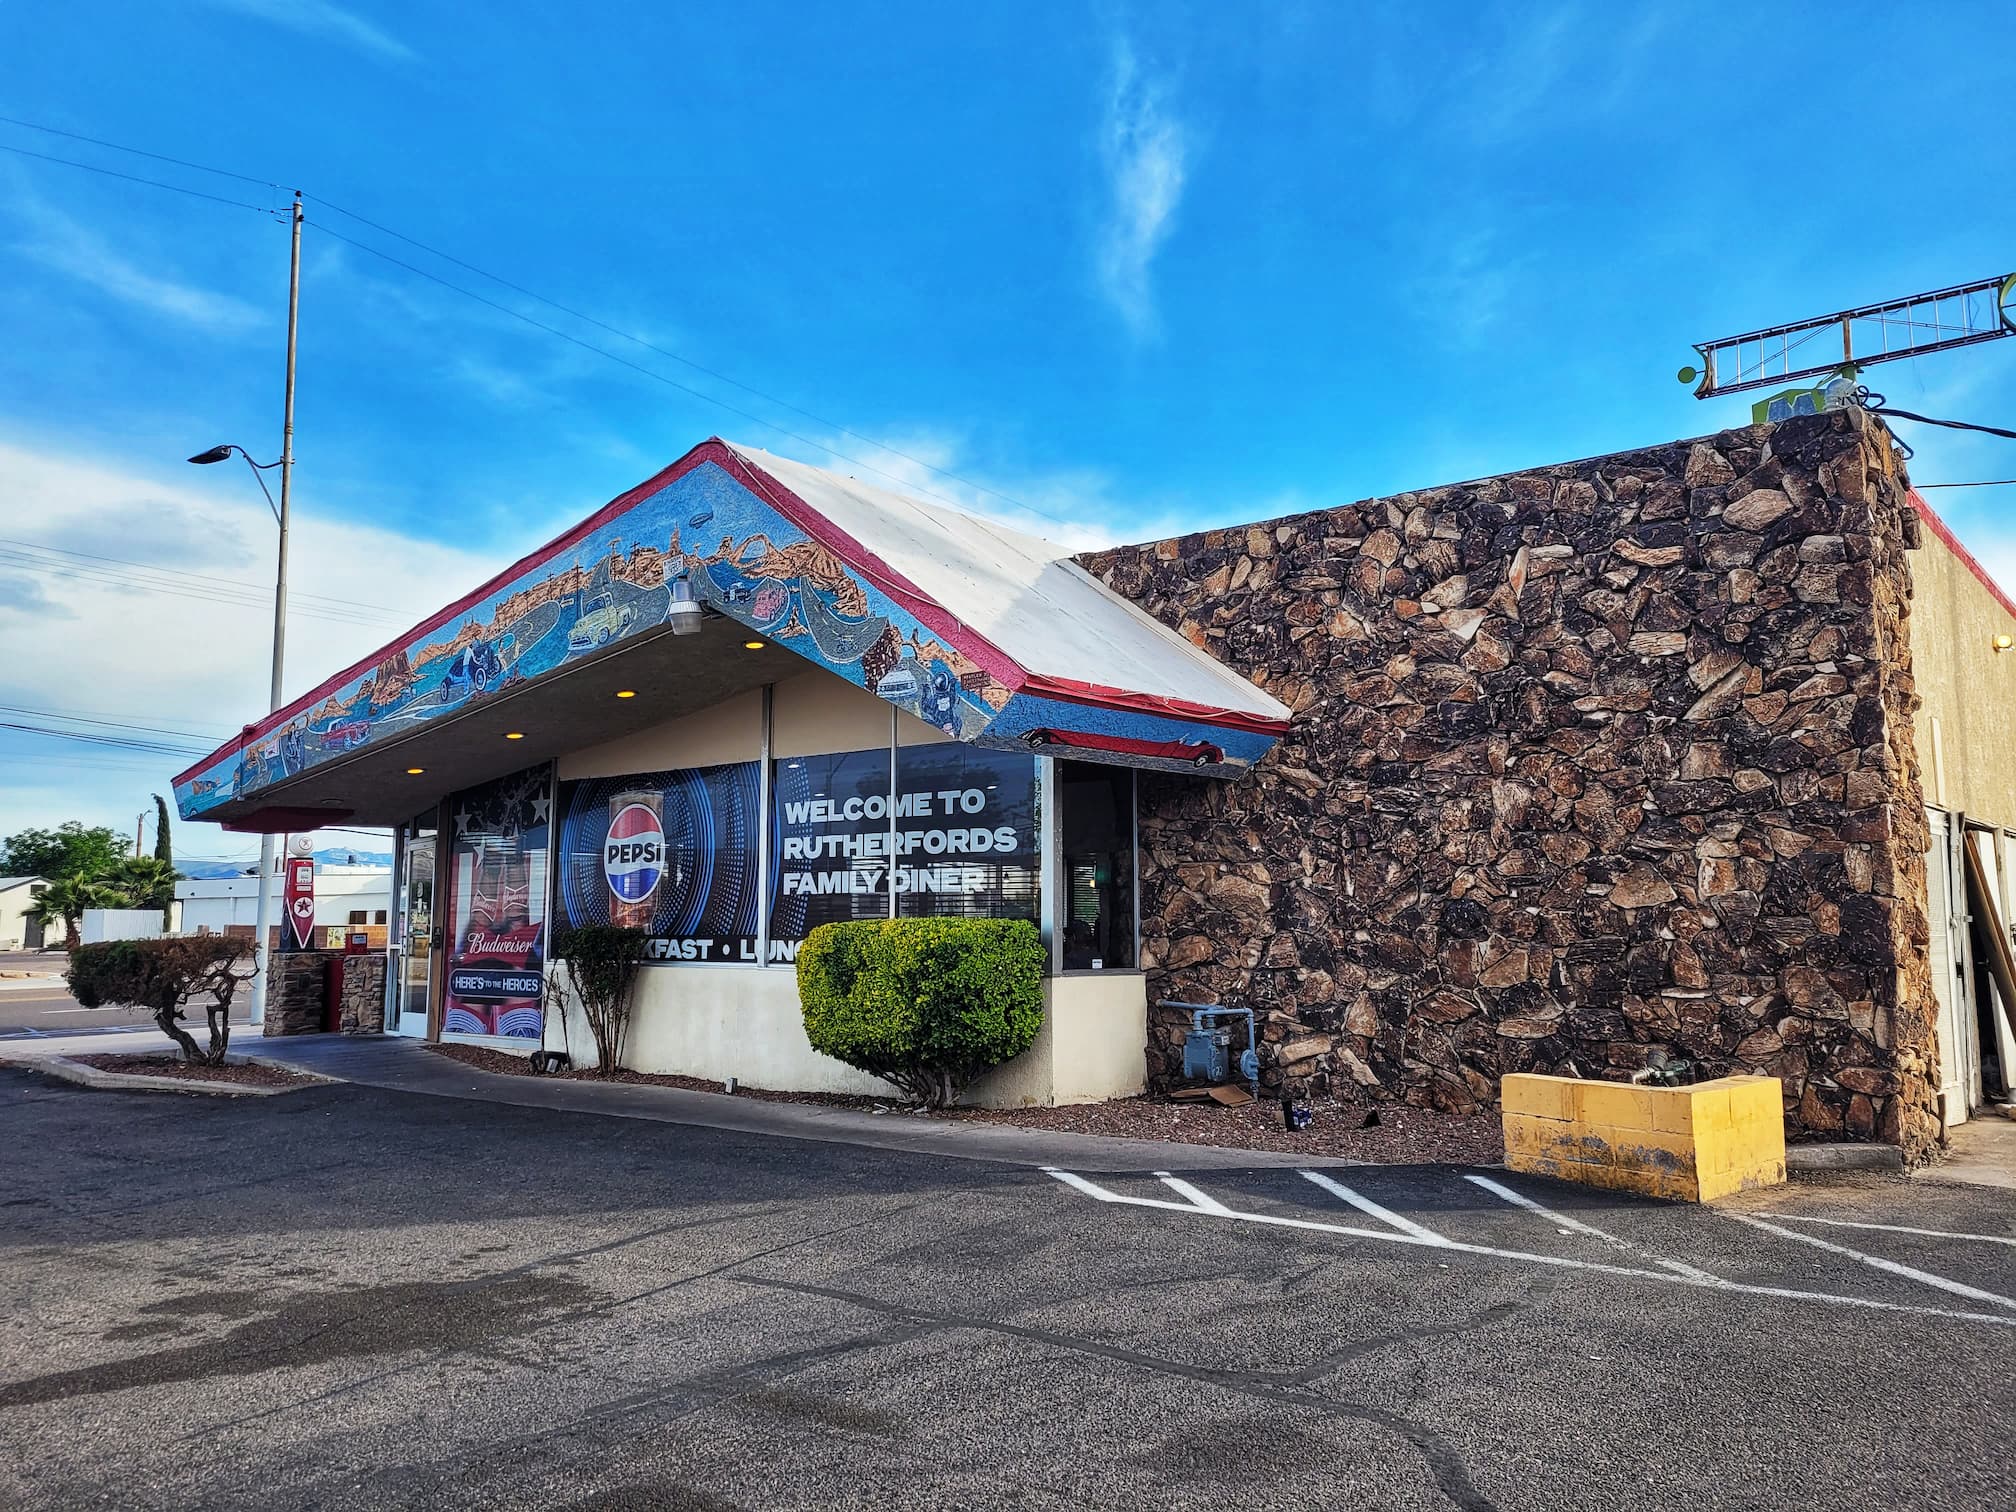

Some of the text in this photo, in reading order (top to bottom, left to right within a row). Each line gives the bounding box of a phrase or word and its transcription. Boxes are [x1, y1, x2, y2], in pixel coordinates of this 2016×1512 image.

[784, 788, 986, 825] WELCOME TO
[608, 843, 661, 864] PEPSI
[783, 826, 1018, 860] RUTHERFORDS
[783, 868, 985, 896] FAMILY DINER
[467, 932, 533, 954] Budweiser
[454, 976, 485, 990] HERE'S
[502, 977, 539, 992] HEROES
